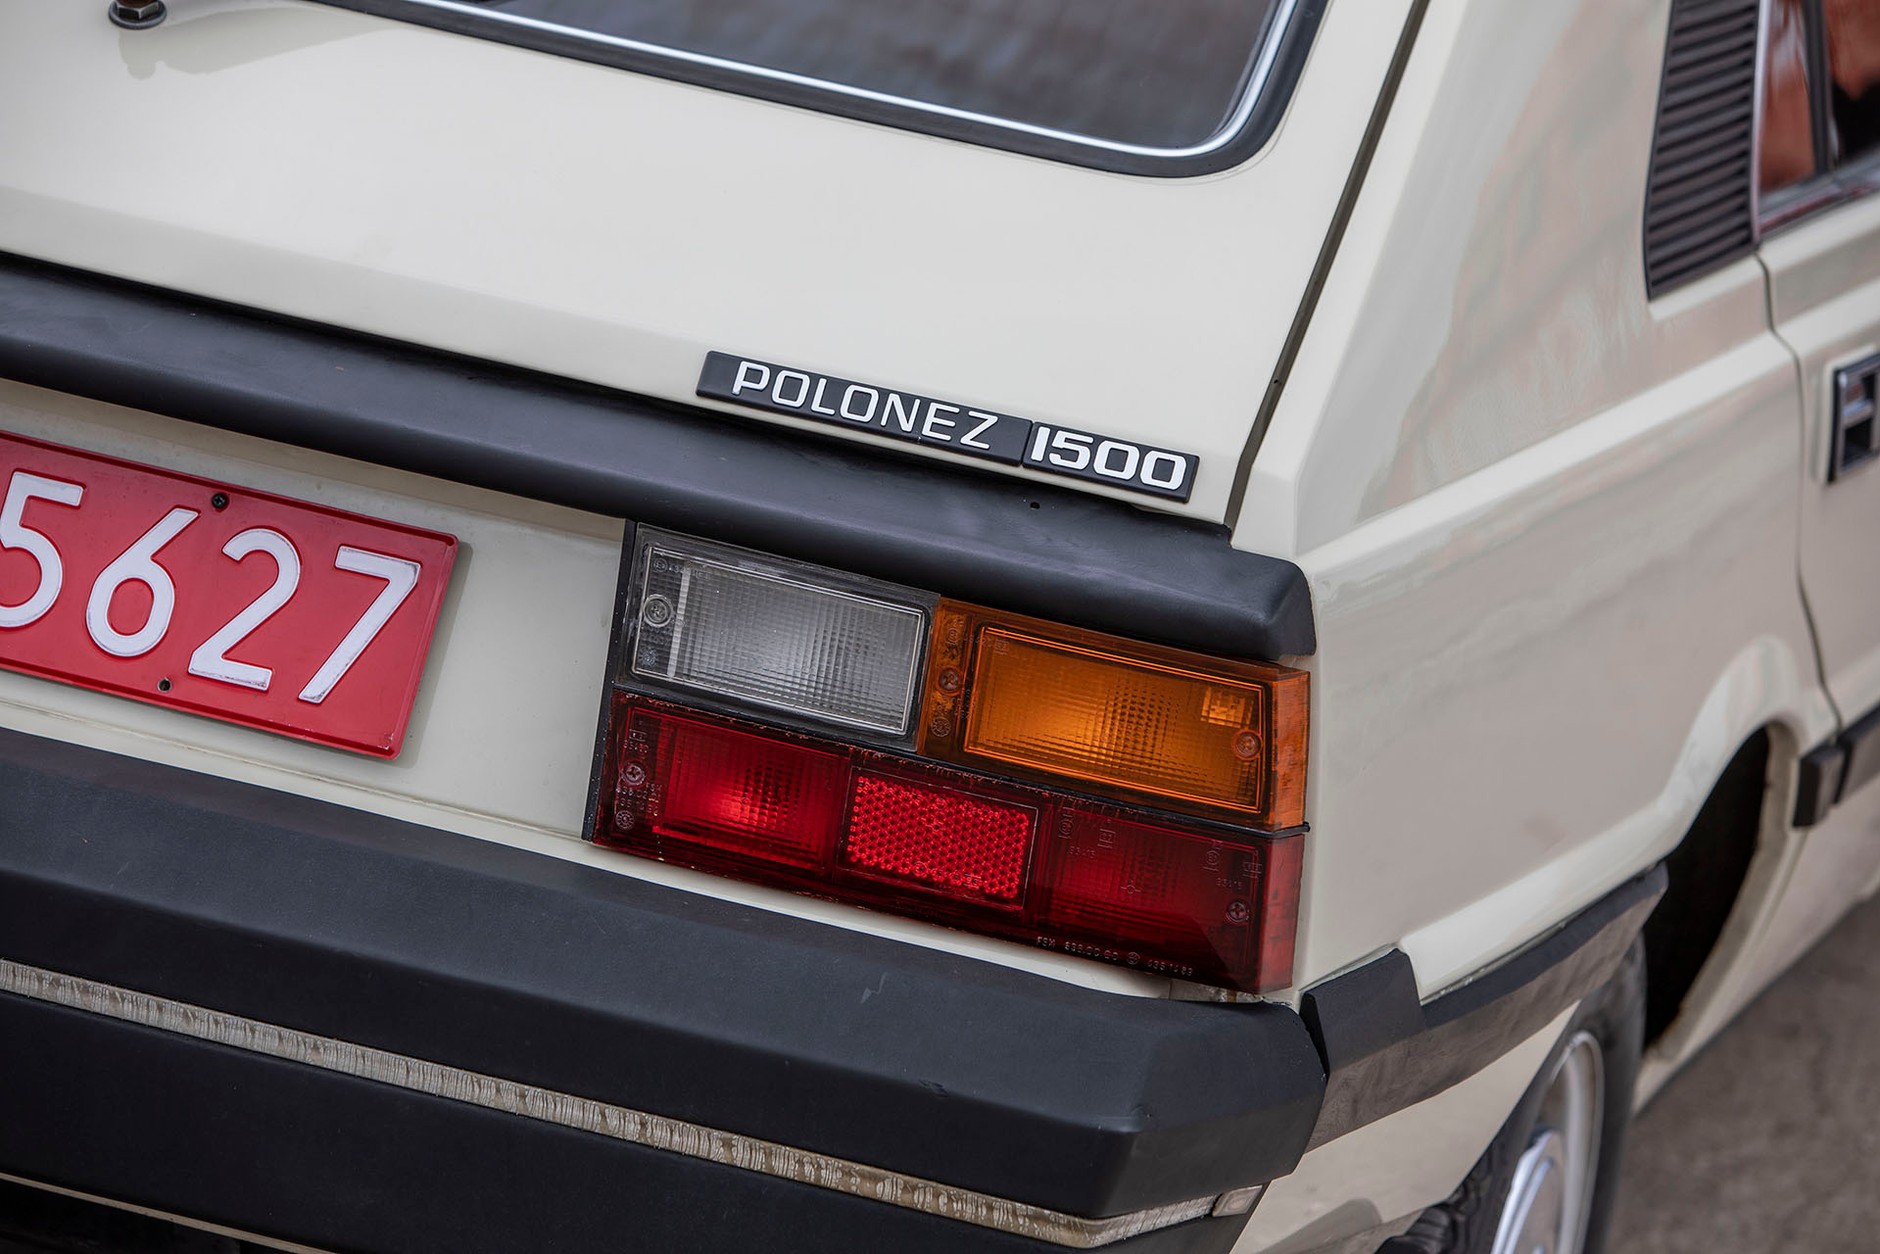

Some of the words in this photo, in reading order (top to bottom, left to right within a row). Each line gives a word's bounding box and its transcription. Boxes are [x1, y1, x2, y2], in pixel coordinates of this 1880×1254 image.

[732, 360, 998, 450] POLONEZ
[1030, 425, 1187, 491] 1500
[0, 471, 421, 704] 5627
